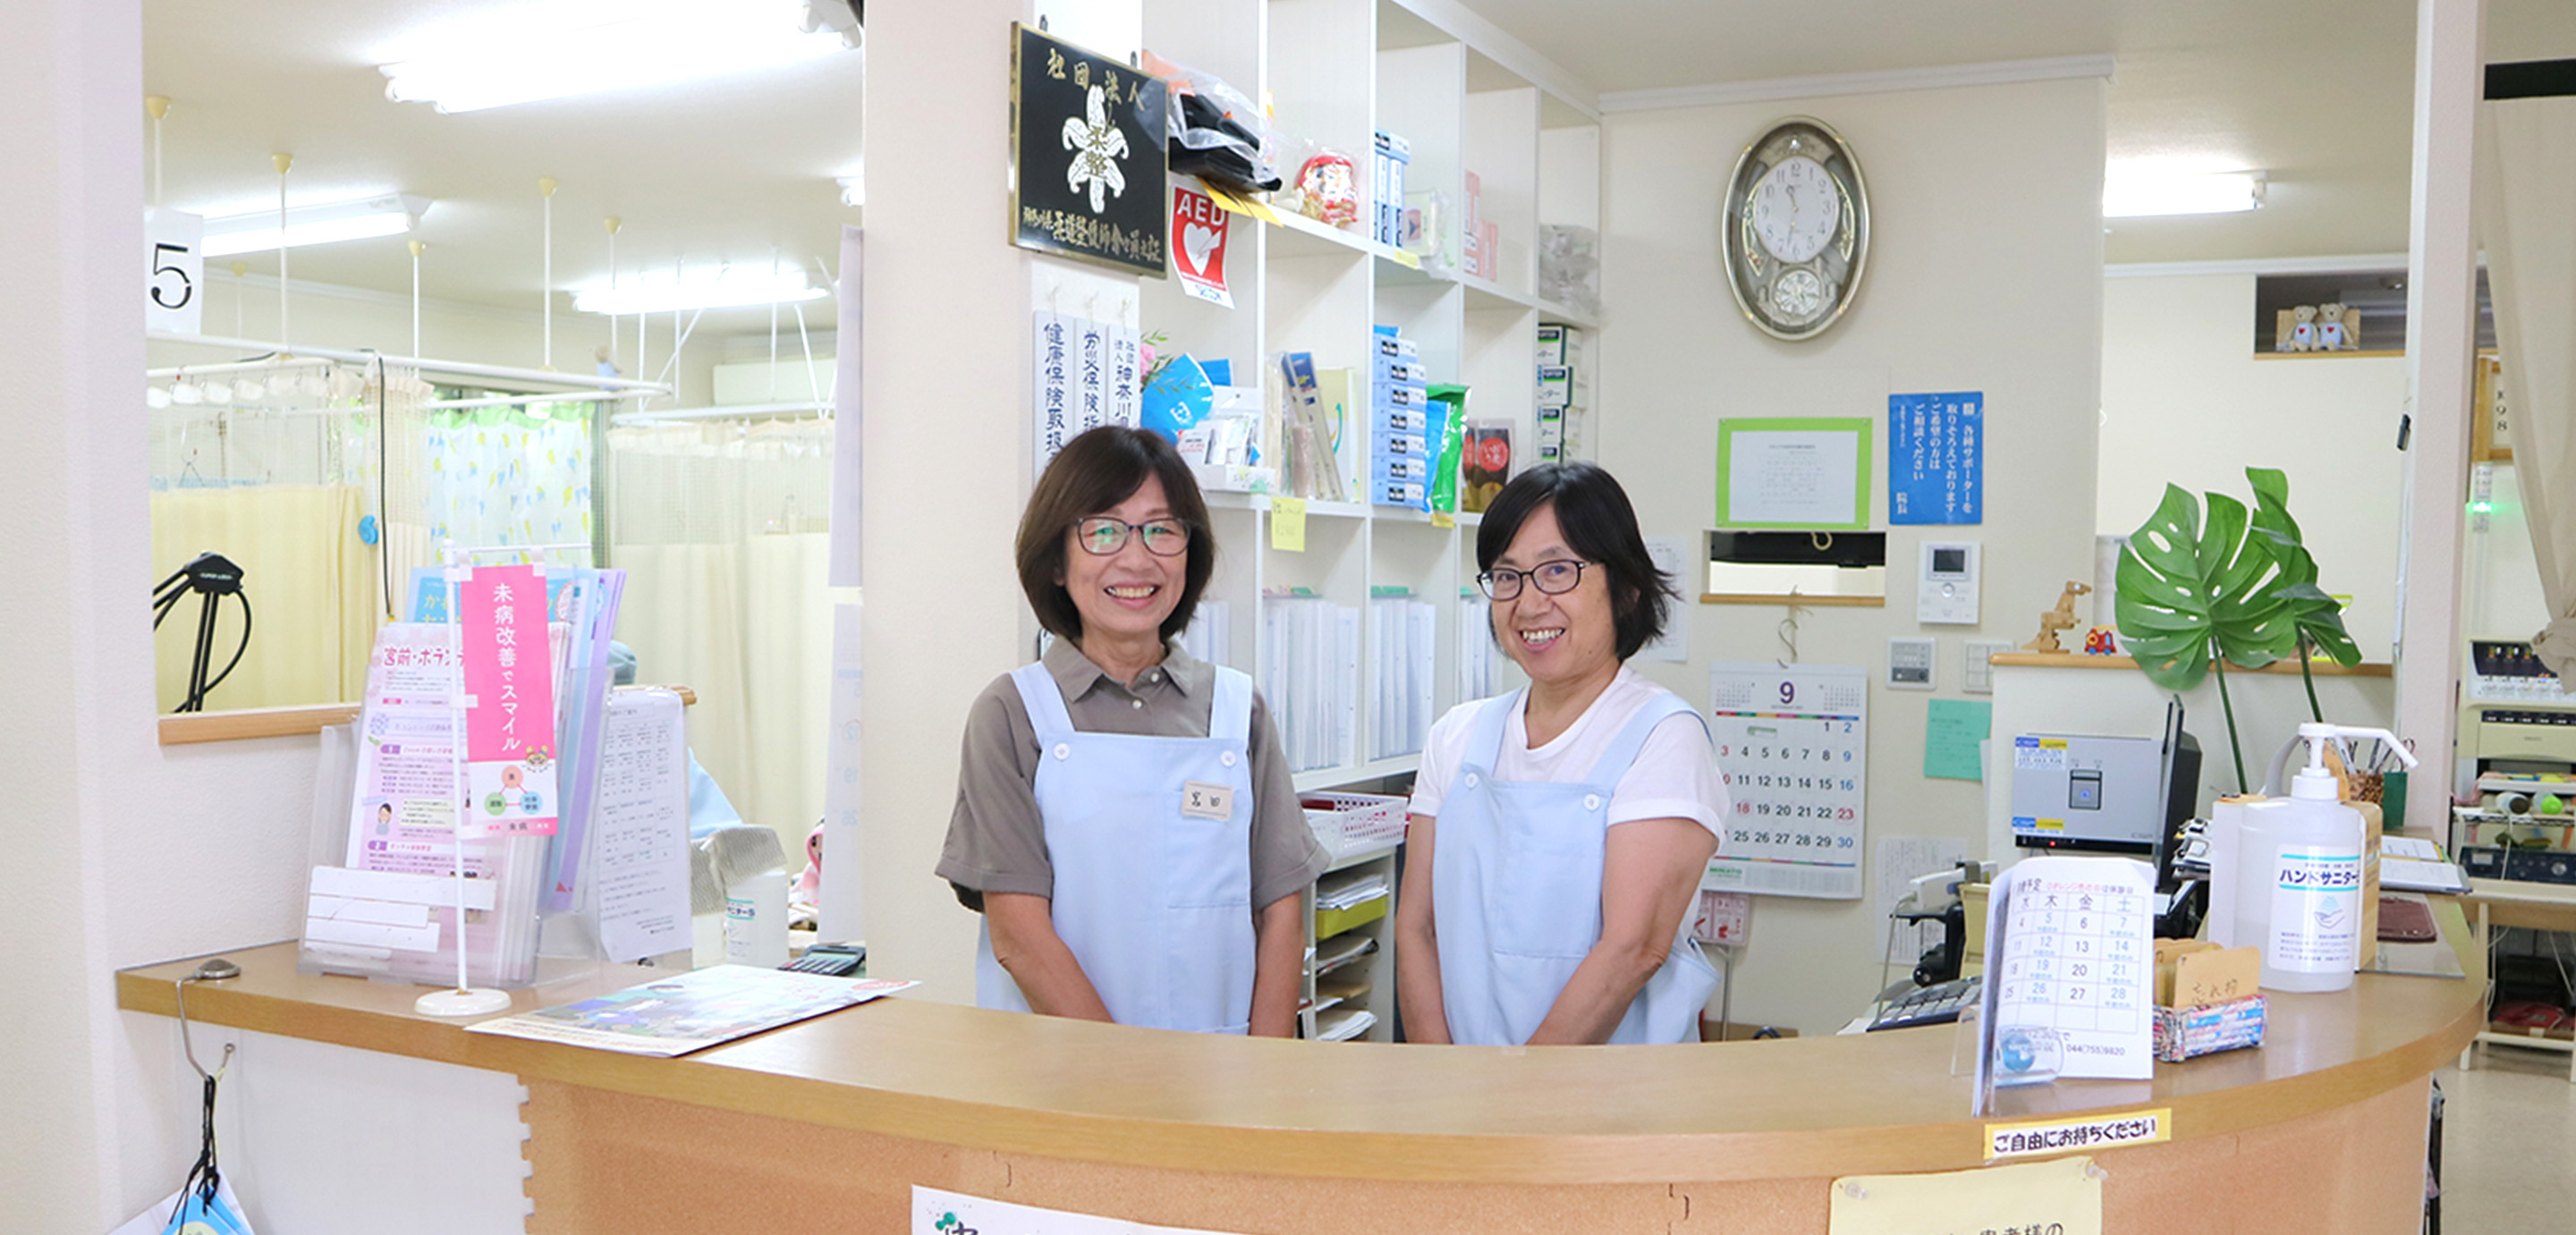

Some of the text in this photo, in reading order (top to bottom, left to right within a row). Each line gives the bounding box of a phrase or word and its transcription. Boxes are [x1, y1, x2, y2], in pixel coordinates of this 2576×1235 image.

[1776, 169, 1784, 182] 11
[1791, 162, 1801, 177] 12
[1809, 166, 1813, 181] 1
[1766, 184, 1775, 197] 10
[1818, 179, 1826, 194] 2
[1177, 193, 1225, 225] AED
[1762, 205, 1769, 218] 9
[1823, 200, 1831, 215] 3
[1766, 224, 1774, 240] 8
[1818, 221, 1826, 234] 4
[1776, 238, 1784, 252] 7
[1807, 235, 1815, 250] 5
[1792, 243, 1801, 260] 6
[150, 242, 192, 309] 5
[1913, 403, 1926, 480] ご相談ください
[1945, 404, 1958, 512] 取りそろえております
[493, 583, 521, 752] 未病改善でスマイル
[1779, 681, 1795, 704] 9
[1825, 722, 1852, 732] 1 2
[1721, 745, 1852, 762] 3 4 5 6 7 8 9
[1738, 774, 1750, 785] 11
[1758, 775, 1771, 787] 12
[1778, 776, 1791, 788] 13
[1799, 777, 1811, 788] 14
[1818, 778, 1832, 790] 15
[1840, 779, 1853, 791] 16
[1737, 802, 1854, 819] 18 19 20 21 22 23
[1734, 831, 1853, 849] 25 26 27 28 29 30
[2045, 895, 2057, 908] 木
[2079, 894, 2093, 910] 金
[2117, 898, 2131, 912] 土
[2045, 912, 2053, 924] 5
[2080, 917, 2088, 929] 6
[2121, 917, 2127, 927] 7
[2014, 935, 2129, 952] 11 12 13 14
[2012, 959, 2126, 977] 18 19 20 21
[2004, 982, 2126, 1000] 25 26 27 28
[1994, 1119, 2156, 1153] ご自由にお持ちください
